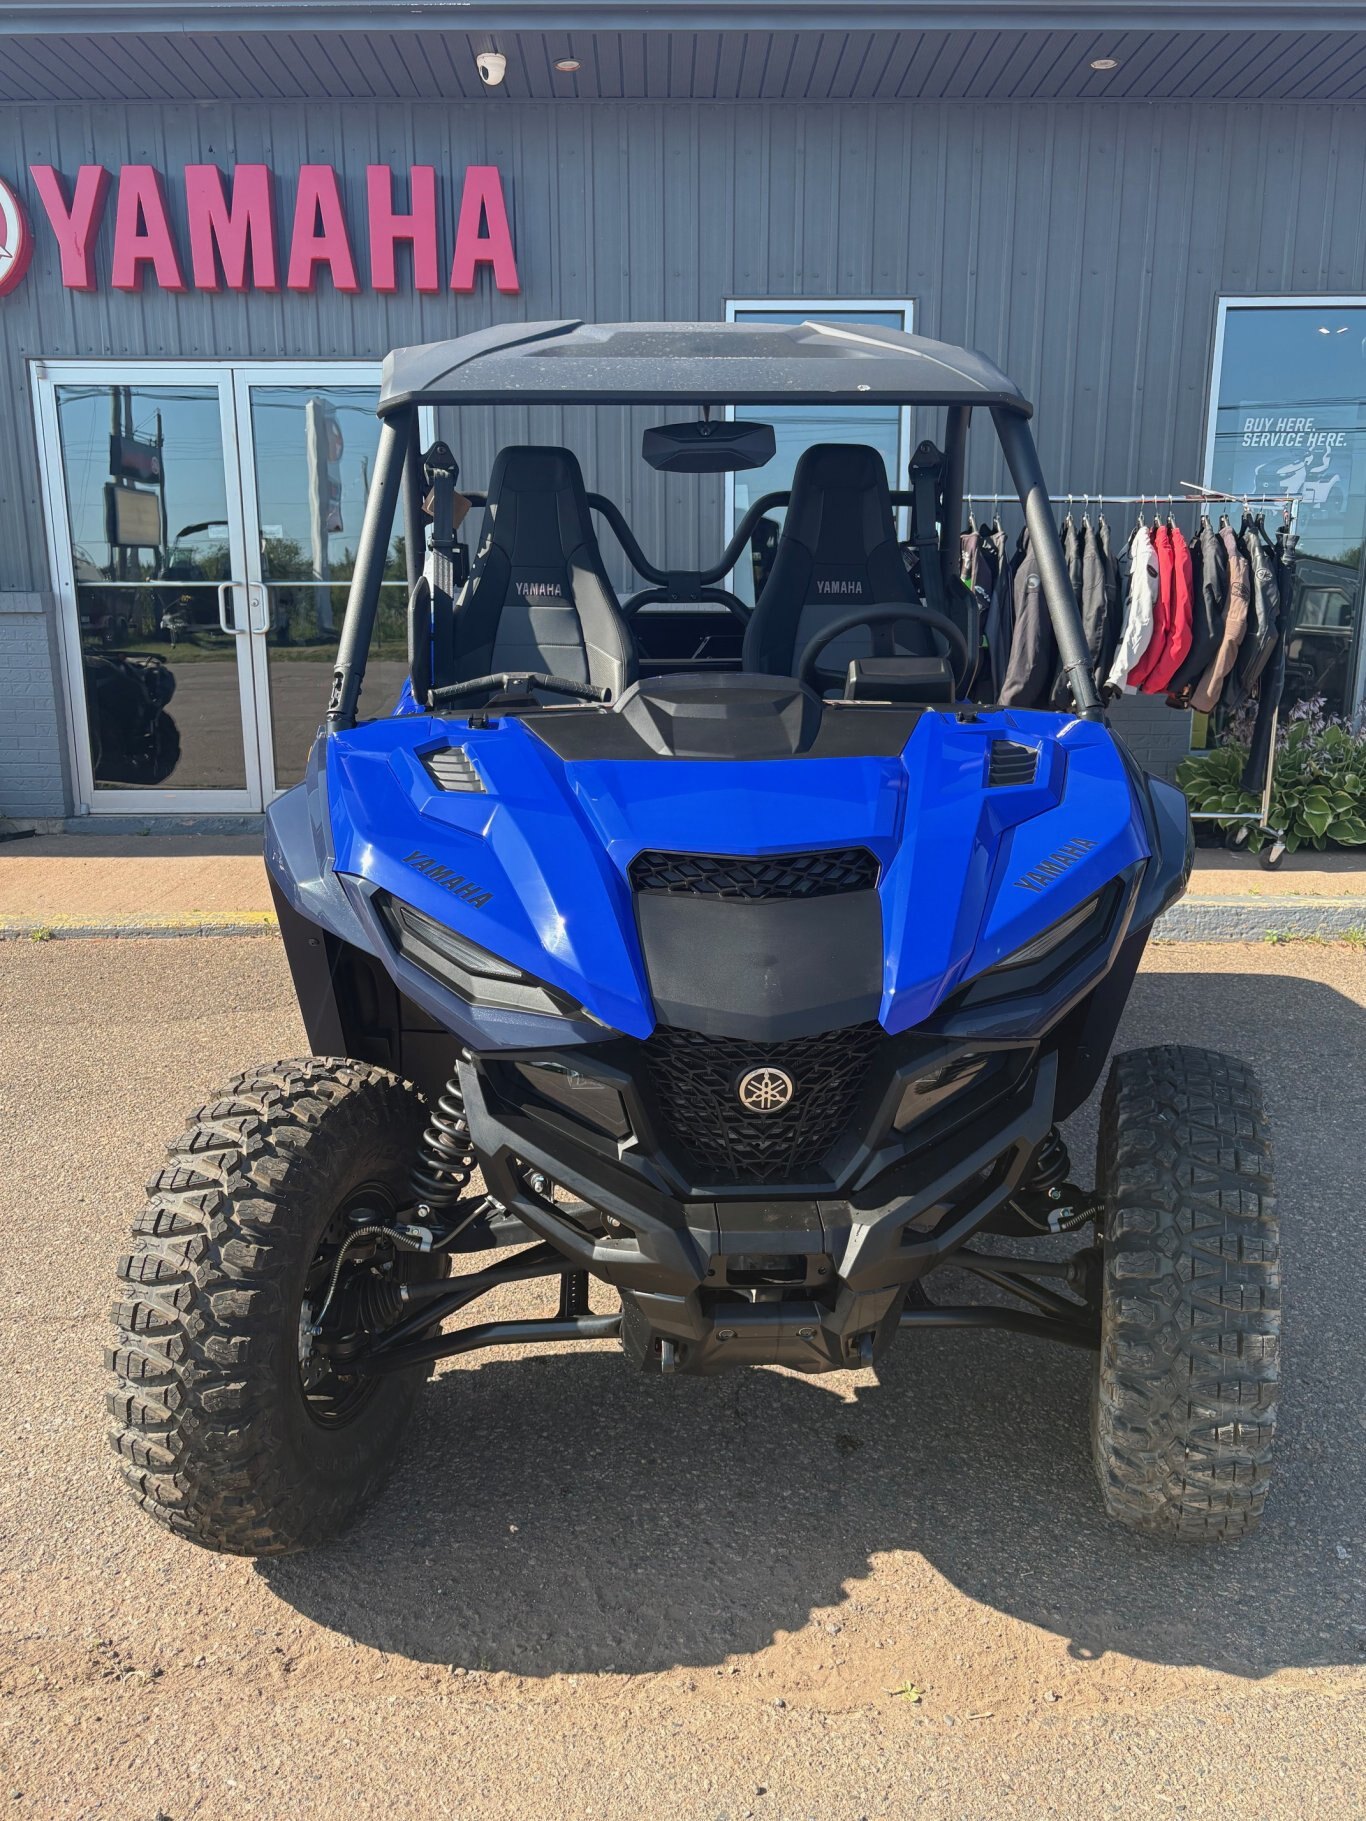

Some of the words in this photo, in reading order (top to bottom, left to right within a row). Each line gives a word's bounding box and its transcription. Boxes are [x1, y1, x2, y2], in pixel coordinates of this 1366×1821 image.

[29, 164, 520, 294] YAMAHA
[1243, 417, 1274, 432] BUY
[1275, 417, 1316, 432] HERE.
[1241, 433, 1305, 447] SERVICE
[1306, 433, 1347, 447] HERE.
[515, 582, 562, 597] YAMAHA
[816, 580, 863, 594] YAMAHA
[1012, 837, 1099, 893] YAMAHA
[402, 850, 494, 909] YAMAHA
